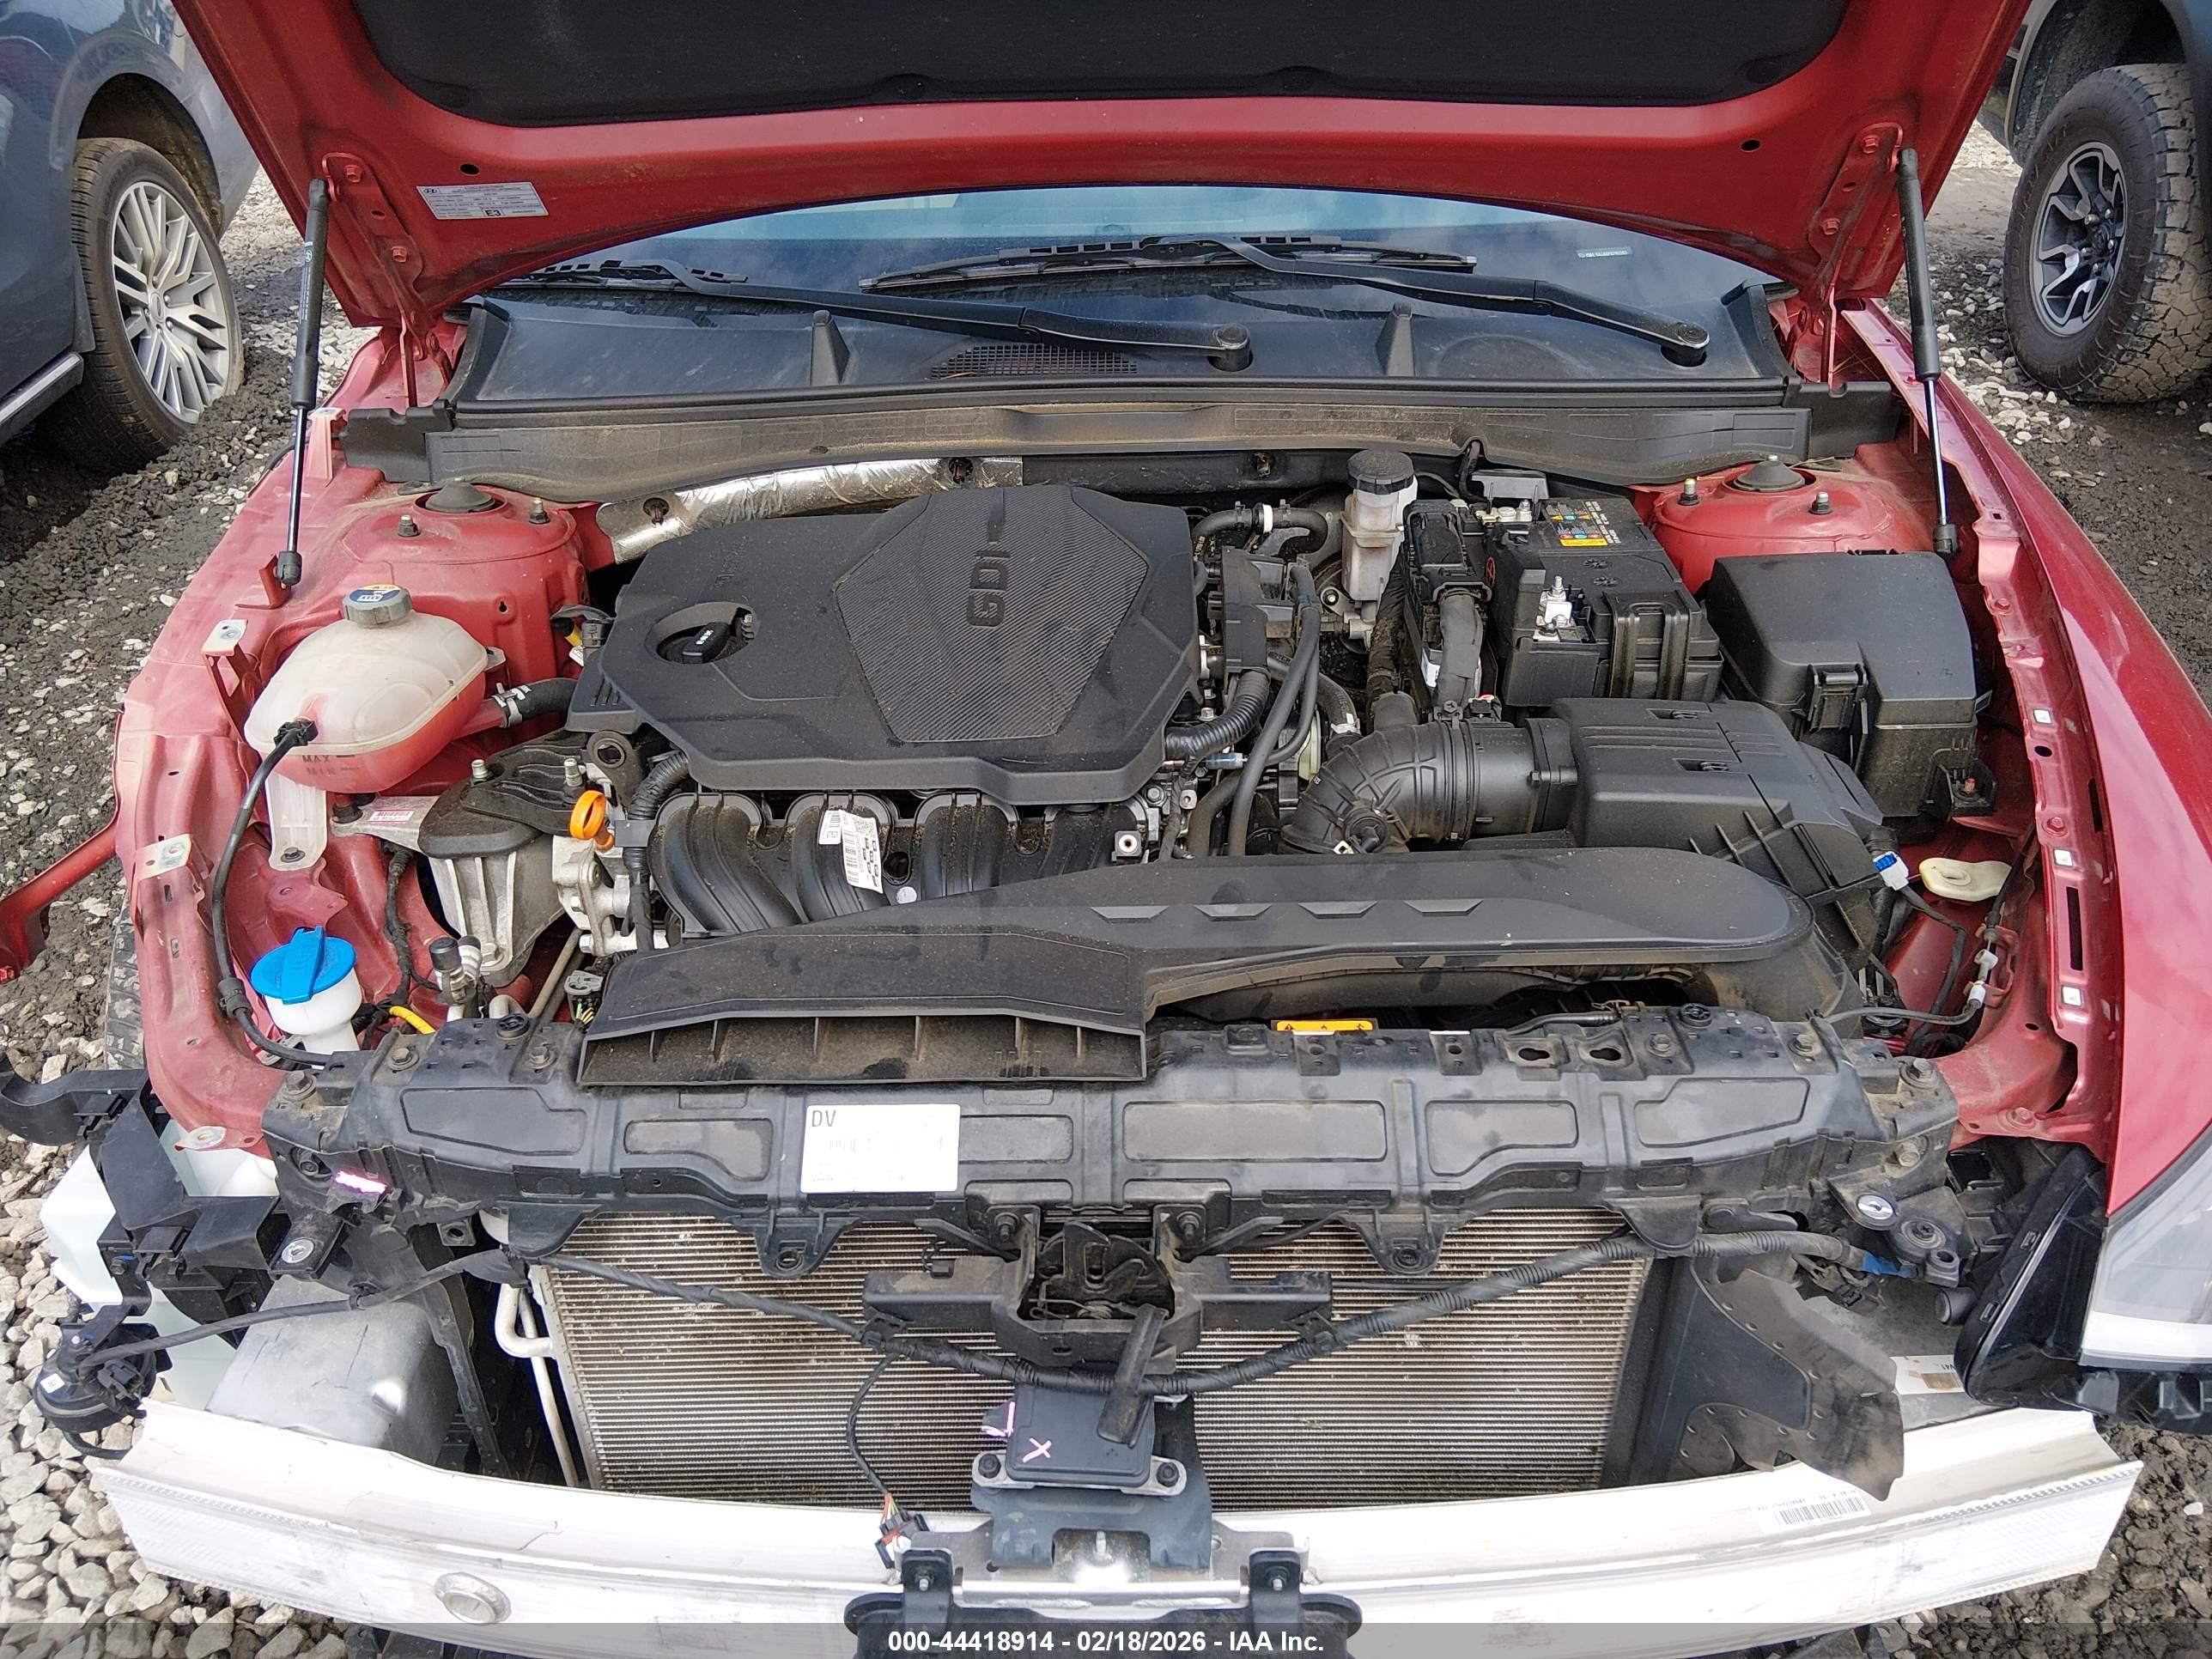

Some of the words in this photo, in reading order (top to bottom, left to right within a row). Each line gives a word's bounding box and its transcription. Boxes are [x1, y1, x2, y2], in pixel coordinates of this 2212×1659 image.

[967, 550, 1011, 627] GDI
[301, 755, 331, 763] MAX
[811, 1109, 836, 1127] DV
